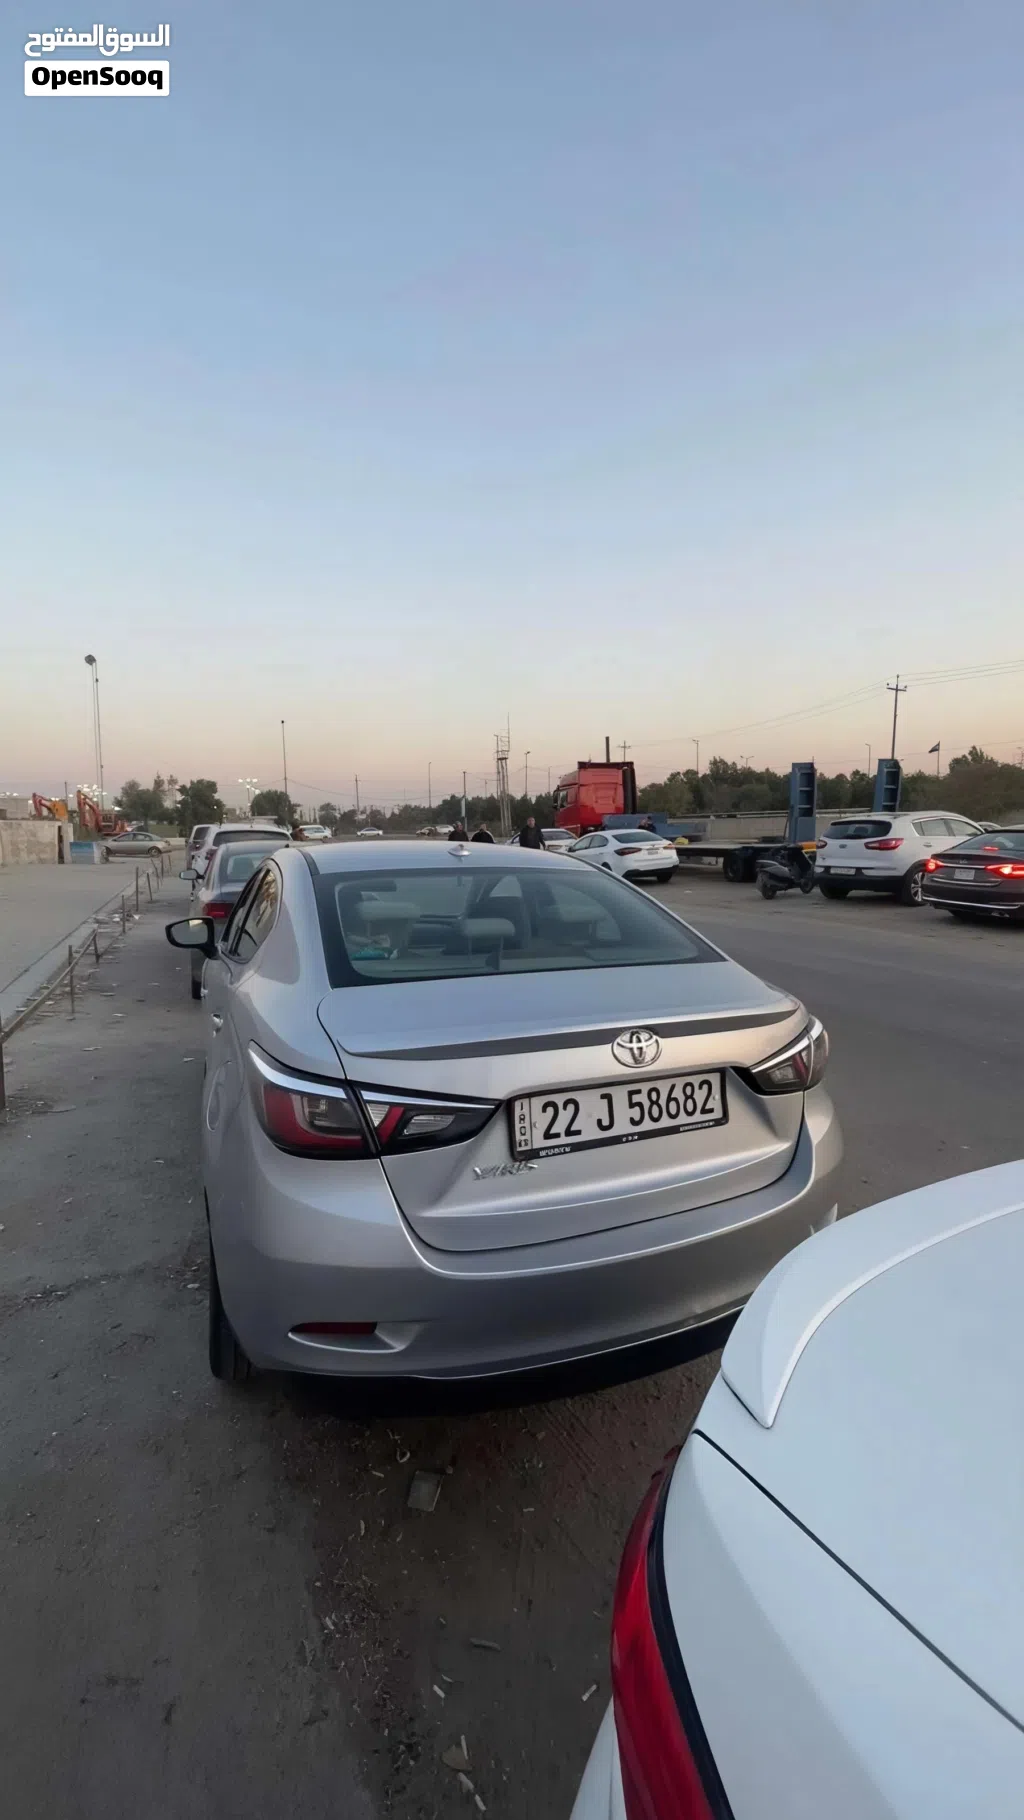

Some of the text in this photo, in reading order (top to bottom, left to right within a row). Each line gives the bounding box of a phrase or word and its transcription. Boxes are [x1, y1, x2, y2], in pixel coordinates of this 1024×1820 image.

[541, 1079, 715, 1140] 22 J 58682
